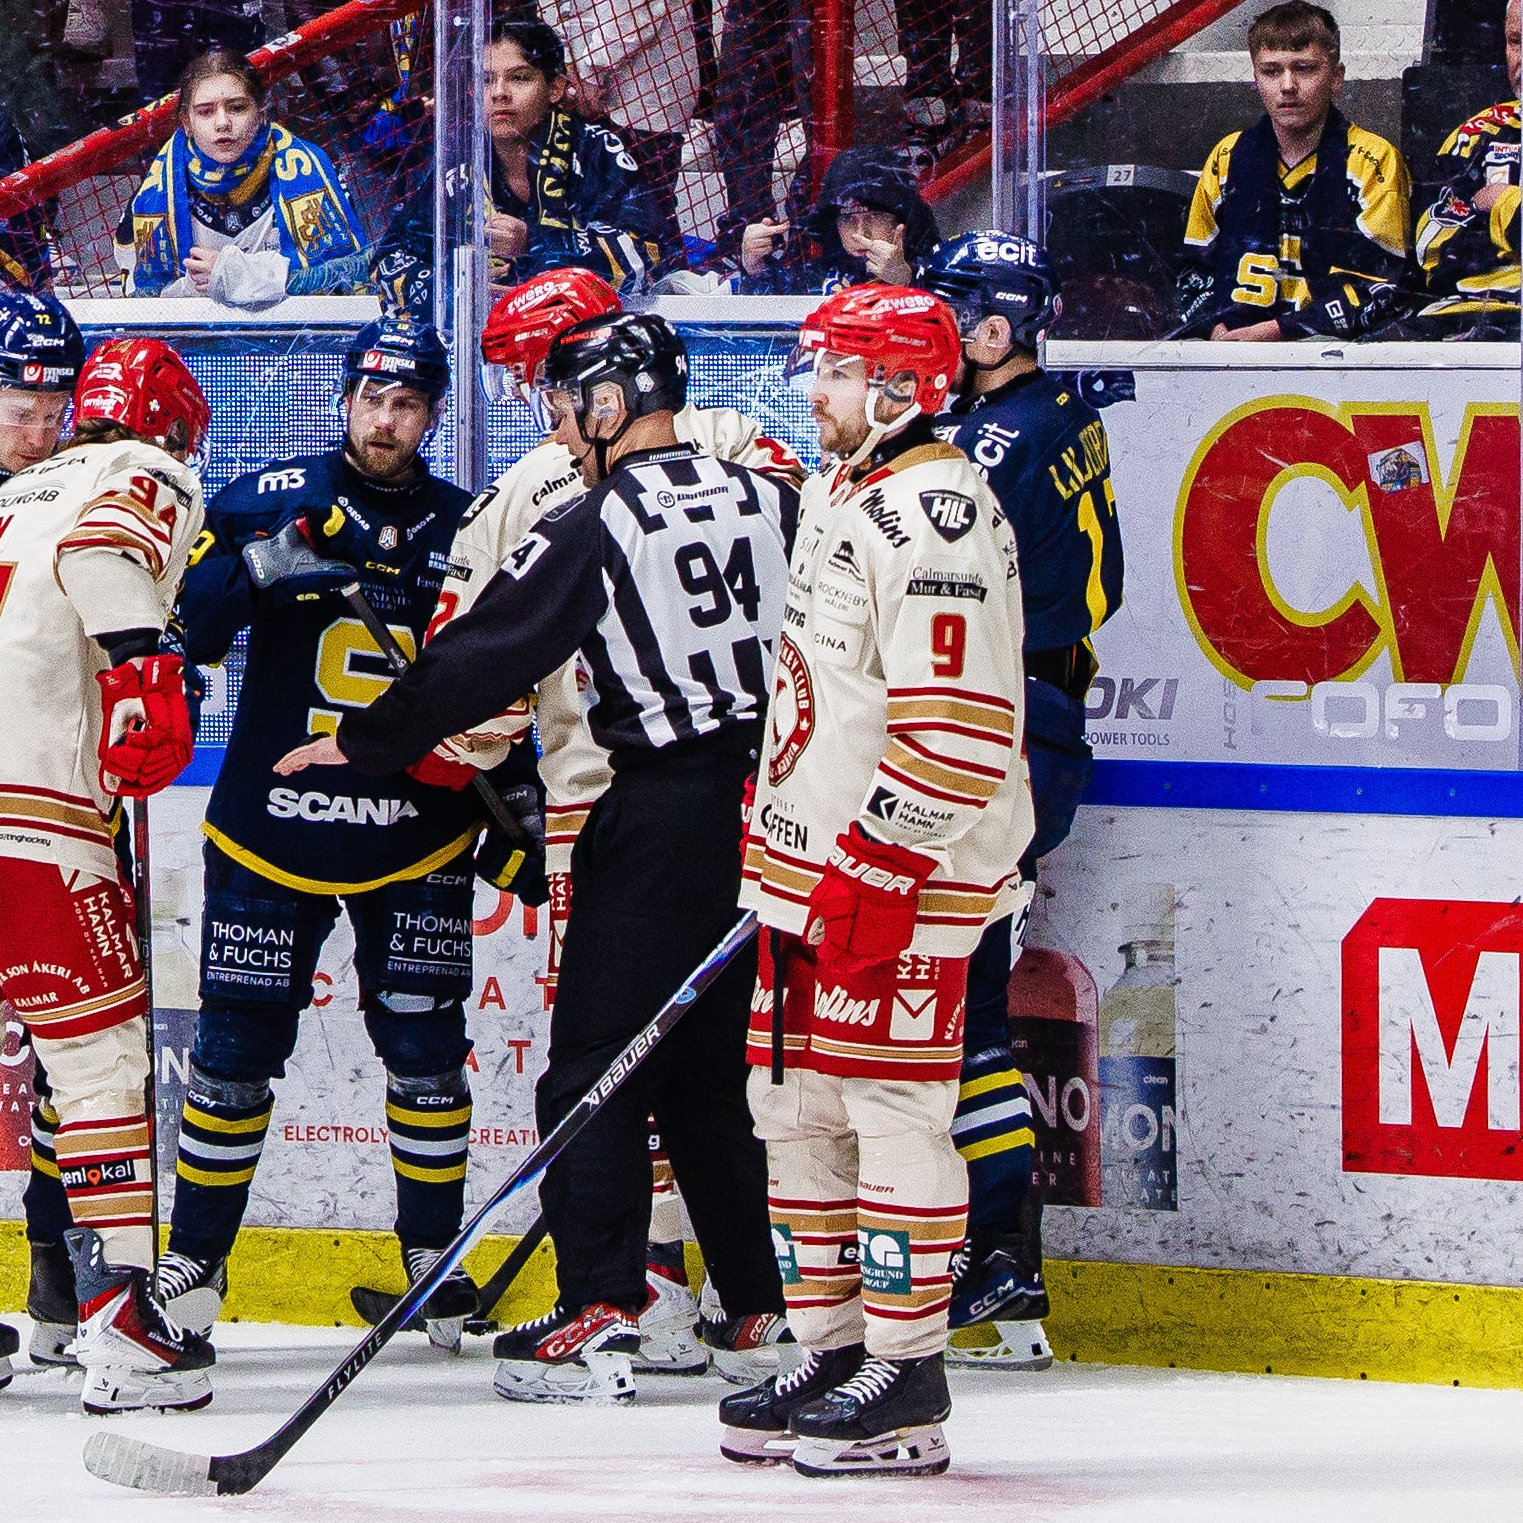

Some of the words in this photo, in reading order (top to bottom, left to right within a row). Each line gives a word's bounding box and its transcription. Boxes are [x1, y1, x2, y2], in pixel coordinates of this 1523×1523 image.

[976, 235, 1037, 265] ecit
[994, 290, 1029, 305] CCM
[858, 487, 911, 549] Molins
[673, 536, 762, 631] 94
[910, 582, 937, 597] Mur
[930, 612, 968, 678] 9
[1130, 731, 1171, 746] TOOLS
[266, 788, 420, 826] SCANIA
[83, 896, 113, 959] HAMN
[96, 891, 134, 980] KALMAR
[211, 921, 295, 948] THOMAN
[392, 911, 473, 936] THOMAN
[208, 943, 221, 962] &
[224, 944, 293, 969] FUCHS
[388, 932, 405, 953] &
[413, 935, 472, 958] FUCHS
[206, 969, 272, 987] ENTREPRENAD
[387, 959, 455, 978] ENTREPRENAD
[13, 991, 60, 1009] KALMAR
[598, 1024, 663, 1099] BAUER
[1143, 1075, 1169, 1086] clean
[416, 1095, 454, 1106] CCM
[326, 1331, 384, 1395] FLYLITE
